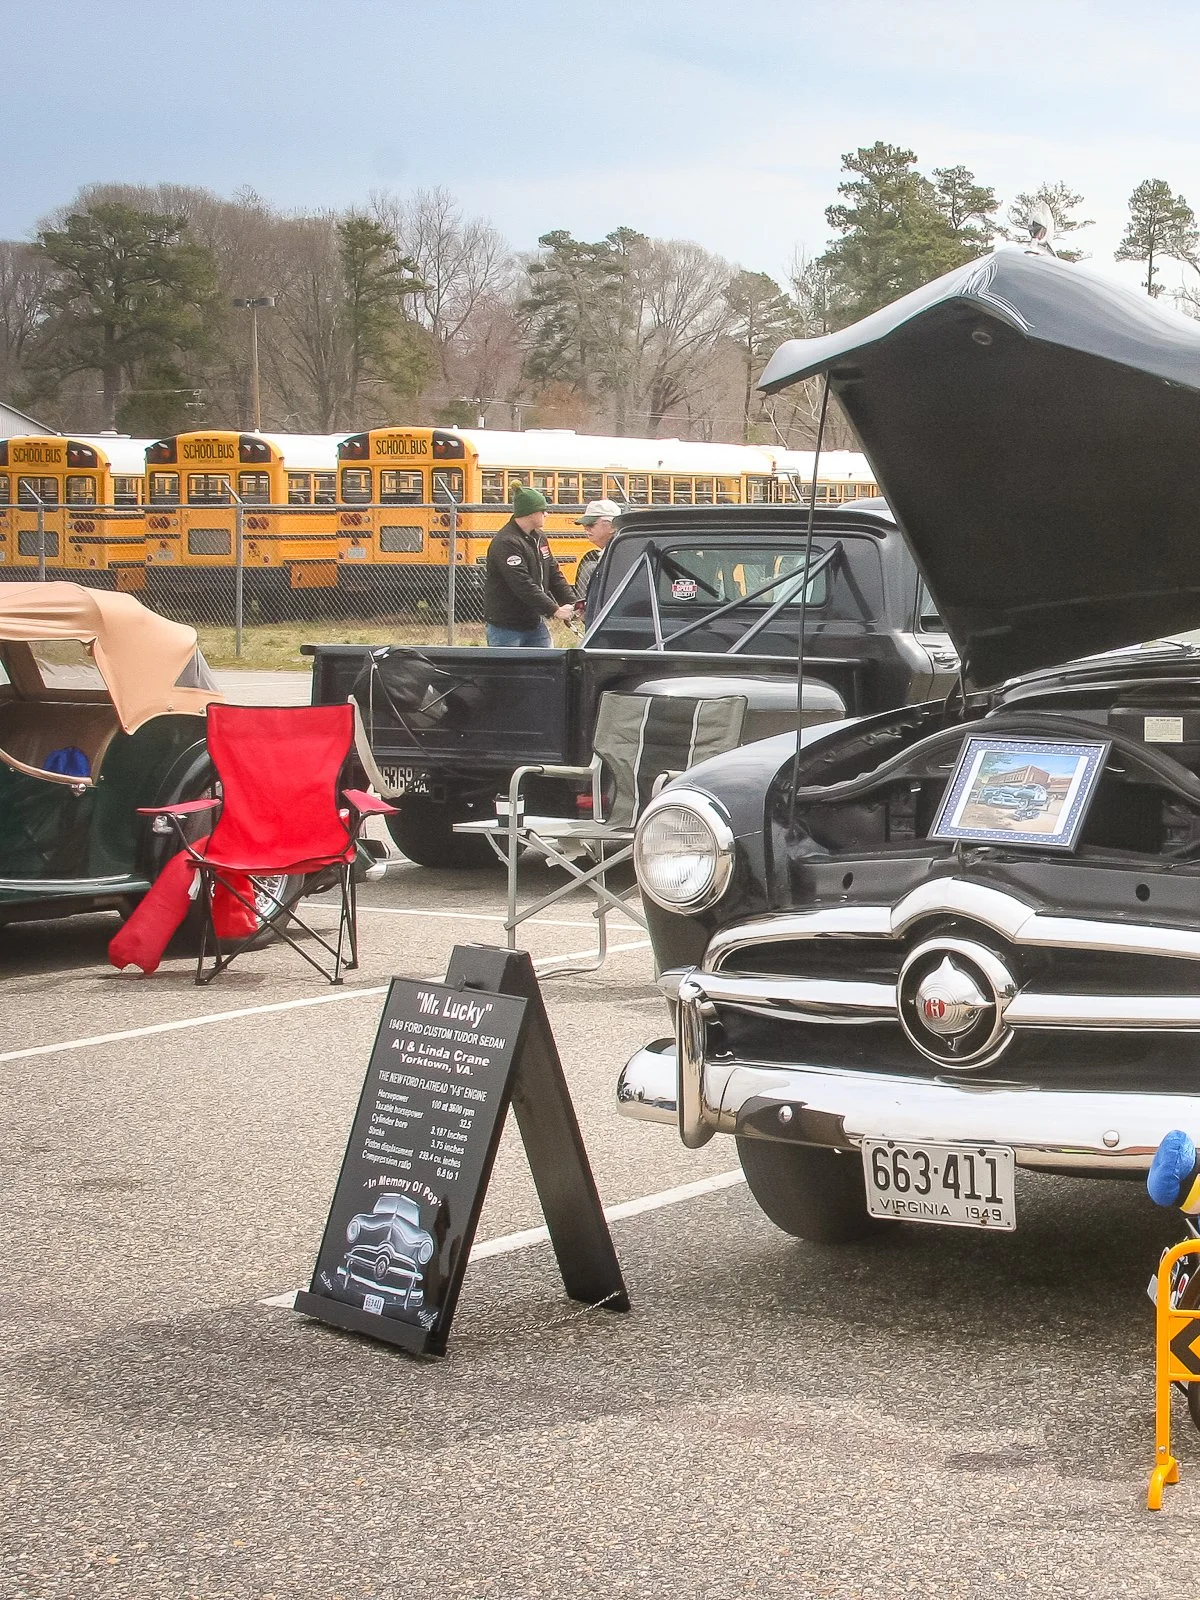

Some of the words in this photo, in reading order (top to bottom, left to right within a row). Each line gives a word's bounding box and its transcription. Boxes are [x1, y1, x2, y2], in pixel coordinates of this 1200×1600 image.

[183, 444, 217, 459] SCHOOL
[217, 444, 235, 459] BUS
[376, 440, 410, 455] SCHOOL
[411, 440, 428, 455] BUS
[13, 448, 45, 463] SCHOOL
[45, 448, 62, 463] BUS
[416, 991, 440, 1016] "Mr.
[442, 996, 493, 1028] Lucky"
[388, 1018, 403, 1031] 1949
[403, 1021, 423, 1034] FORD
[423, 1024, 453, 1039] CUSTOM
[453, 1030, 479, 1045] TUDOR
[478, 1035, 506, 1050] SEDAN
[406, 1041, 416, 1052] &
[418, 1043, 451, 1059] Linda
[453, 1050, 490, 1066] Crane
[400, 1053, 452, 1073] Yorktown,
[455, 1064, 474, 1076] VA.
[378, 1070, 390, 1081] THE
[390, 1072, 403, 1084] NEW
[402, 1074, 419, 1088] FORD
[418, 1078, 449, 1094] FLATHEAD
[463, 1087, 488, 1102] ENGINE
[377, 1088, 410, 1103] Horsepower
[393, 1104, 424, 1119] horsepower
[371, 1113, 395, 1126] Cylinder
[446, 1129, 468, 1142] inches
[443, 1143, 465, 1155] inches
[361, 1150, 398, 1167] Compression
[442, 1156, 461, 1168] inches
[378, 1175, 412, 1192] Memory
[412, 1180, 424, 1193] Of
[879, 1197, 952, 1217] VIRGINIA
[965, 1206, 1002, 1221] 1949
